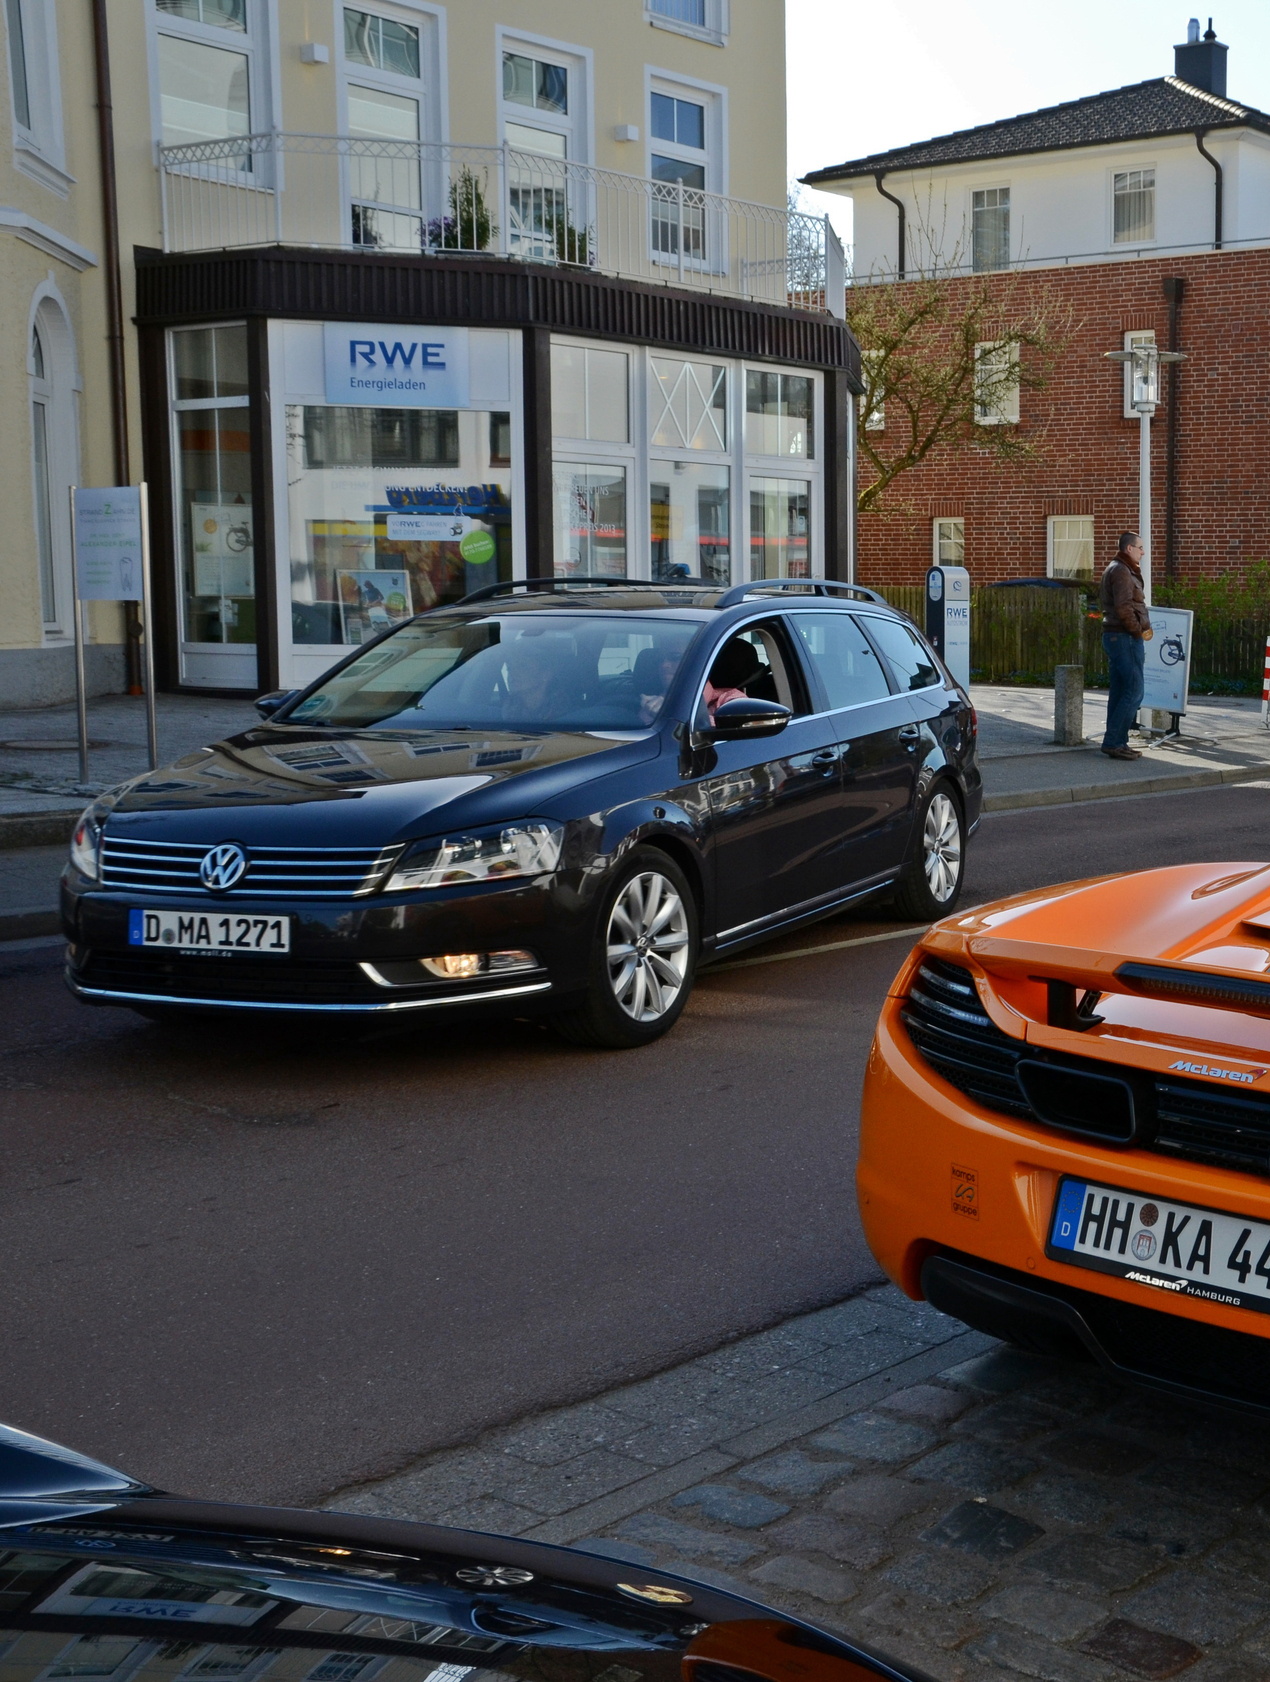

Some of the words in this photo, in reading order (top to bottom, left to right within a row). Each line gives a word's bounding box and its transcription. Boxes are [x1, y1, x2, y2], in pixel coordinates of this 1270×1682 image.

[349, 340, 446, 367] RWE
[350, 377, 426, 391] Energieladen
[947, 608, 968, 617] RWE
[144, 914, 161, 943] D
[178, 916, 212, 945] MA
[218, 918, 286, 949] 1271
[1168, 1060, 1254, 1084] McLaren
[1078, 1193, 1135, 1255] HH
[1158, 1211, 1213, 1275] KA
[1125, 1271, 1181, 1292] McLaren
[1186, 1286, 1241, 1306] HAMBURG
